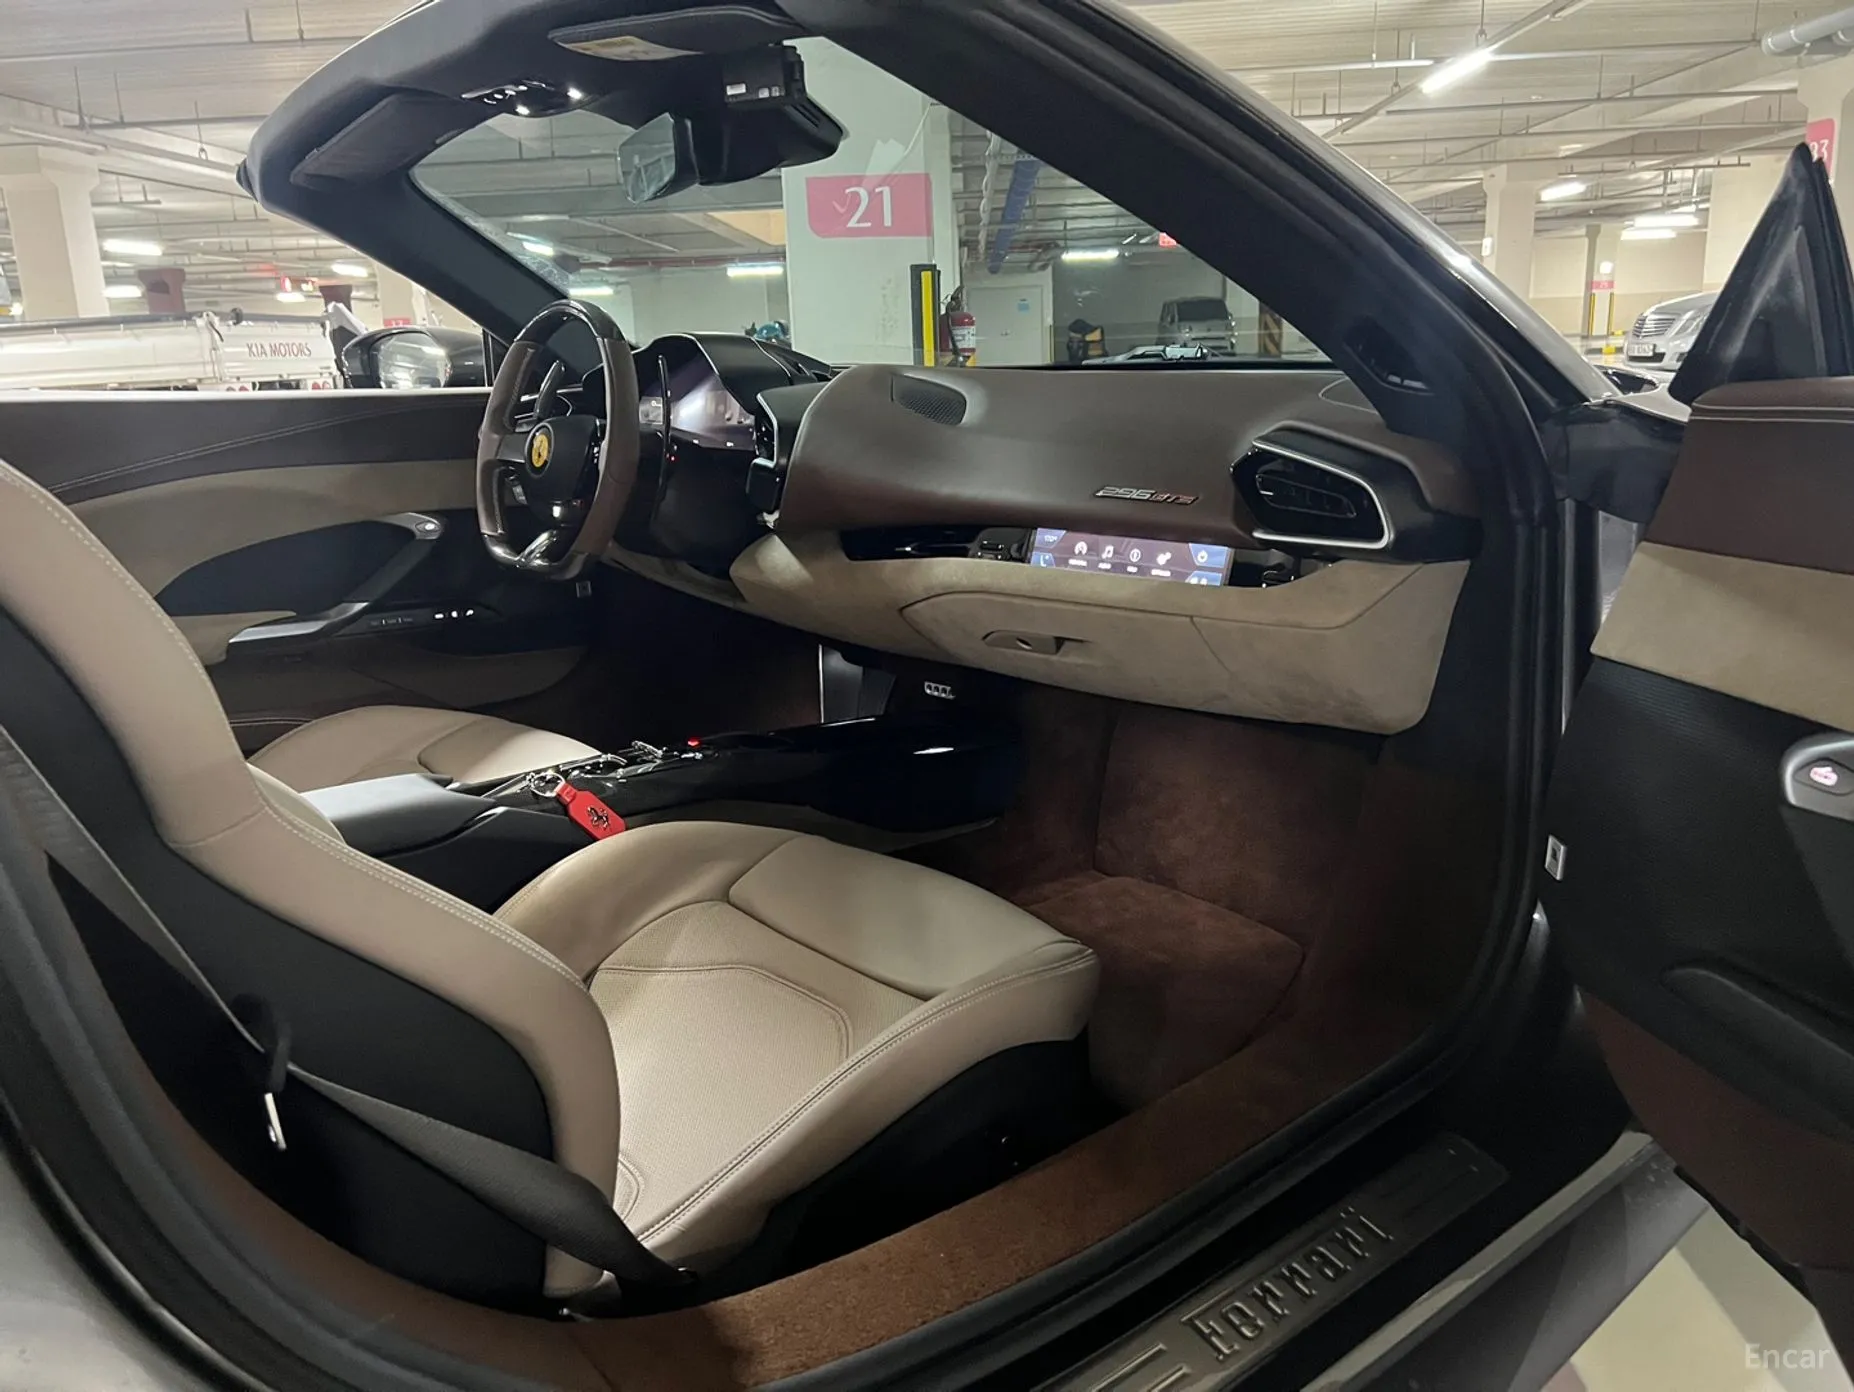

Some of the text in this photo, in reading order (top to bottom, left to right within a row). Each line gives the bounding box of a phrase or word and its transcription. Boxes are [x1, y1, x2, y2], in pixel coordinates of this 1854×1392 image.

[844, 186, 892, 228] 21
[246, 342, 312, 358] KIA MOTORS
[1180, 1206, 1395, 1361] Ferrari
